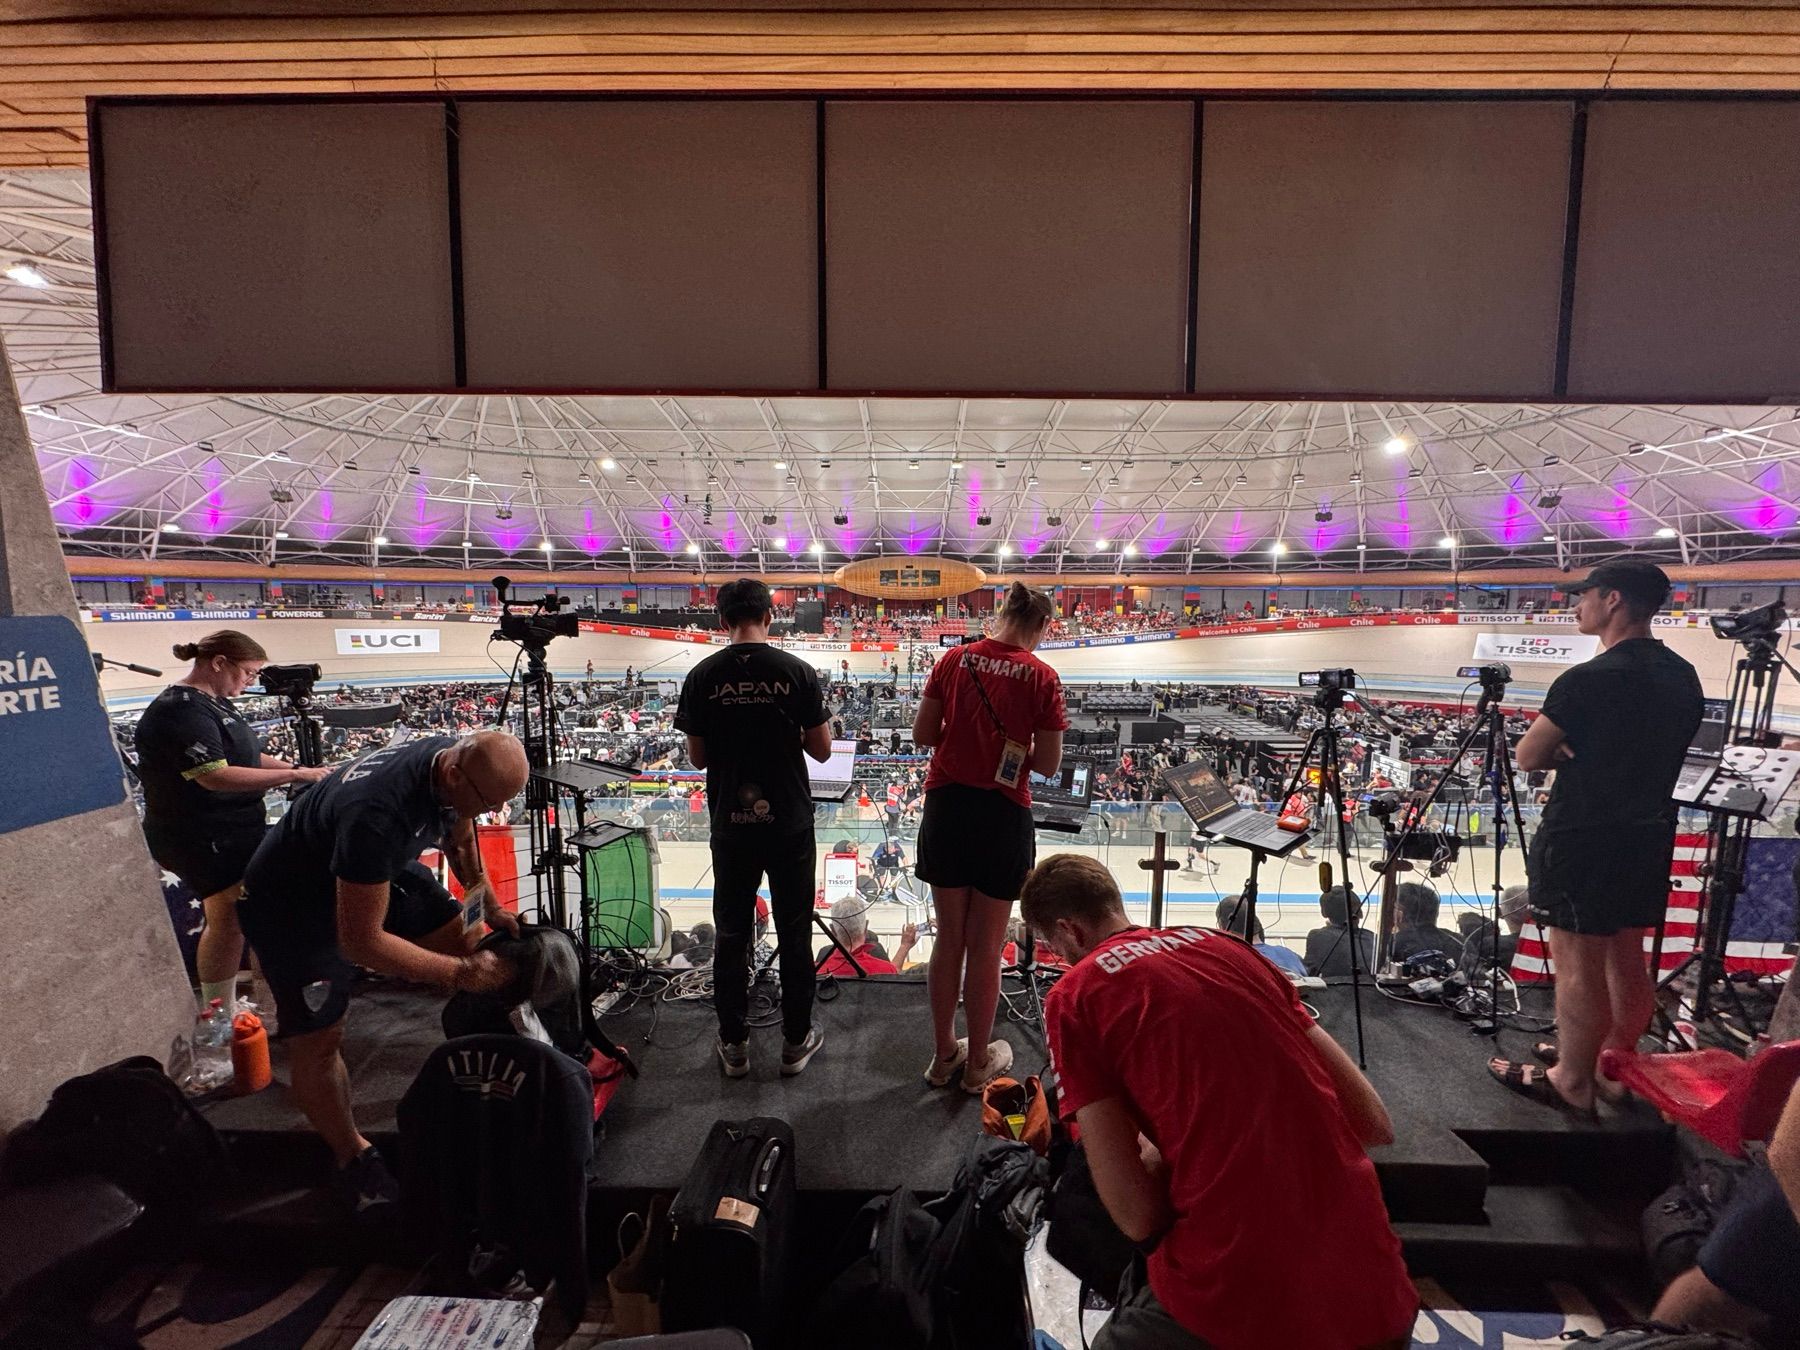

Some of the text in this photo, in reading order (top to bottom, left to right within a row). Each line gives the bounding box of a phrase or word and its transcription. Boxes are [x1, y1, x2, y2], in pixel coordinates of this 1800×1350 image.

[111, 611, 175, 621] SHIMANO
[191, 610, 250, 619] SHIMANO
[413, 612, 445, 621] Santini
[469, 615, 500, 624] Santini
[1350, 618, 1375, 626] Chile
[1414, 616, 1441, 625] Chile
[1297, 620, 1320, 629] Chile
[1198, 627, 1230, 637] Welcome
[364, 634, 421, 648] UCI
[1089, 637, 1125, 646] SHIMANO
[1134, 632, 1171, 642] SHIMANO
[1040, 640, 1075, 649] SHIMANO
[1496, 645, 1572, 655] TISSOT
[708, 681, 790, 699] JAPAN
